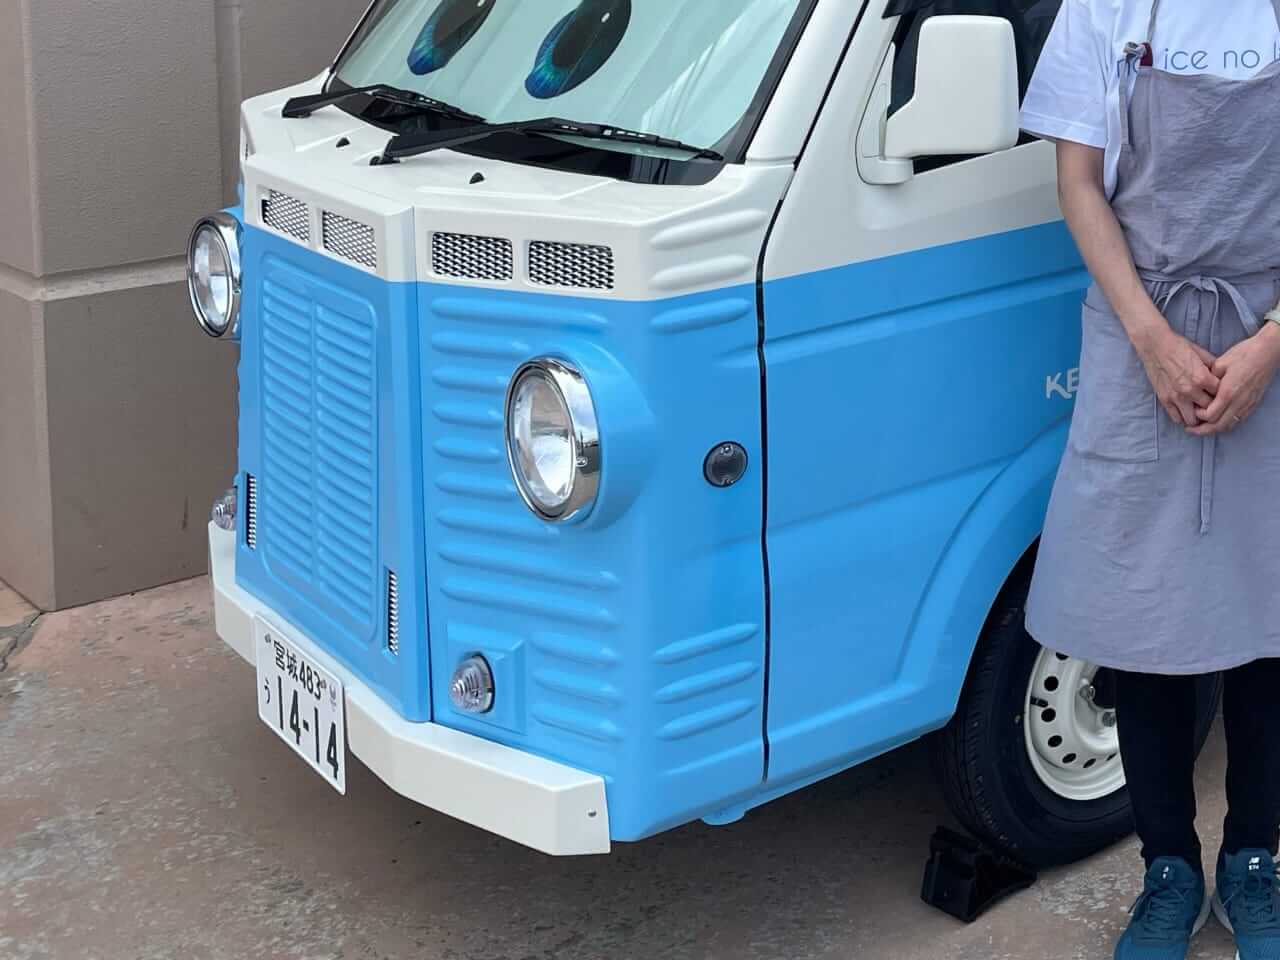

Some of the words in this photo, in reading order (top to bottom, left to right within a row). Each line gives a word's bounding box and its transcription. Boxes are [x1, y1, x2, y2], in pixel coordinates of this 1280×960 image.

[1164, 47, 1208, 71] ice
[1223, 49, 1260, 70] no
[278, 675, 339, 780] 14-14
